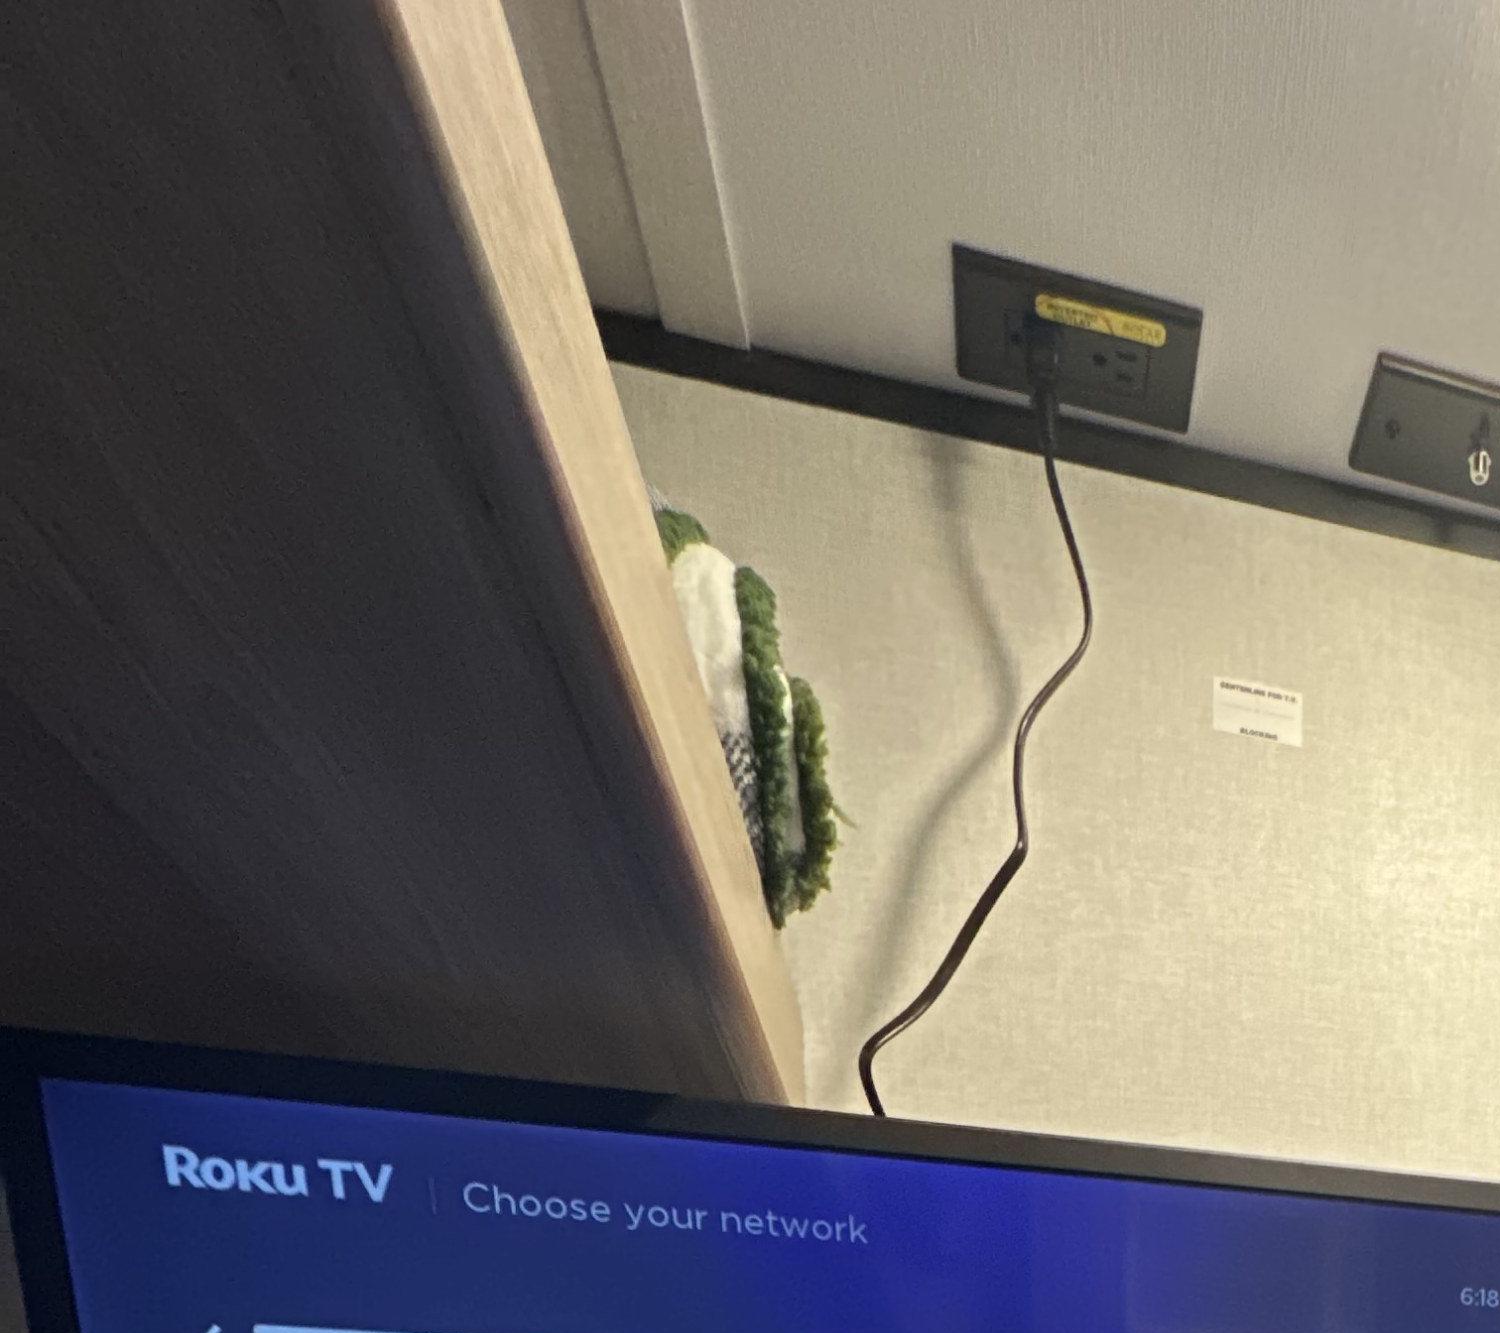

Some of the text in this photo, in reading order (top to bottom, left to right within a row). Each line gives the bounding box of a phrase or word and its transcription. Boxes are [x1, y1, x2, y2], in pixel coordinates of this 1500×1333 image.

[317, 1158, 393, 1203] TV
[463, 1182, 868, 1244] Choose your network
[1460, 1287, 1500, 1308] 6:18
